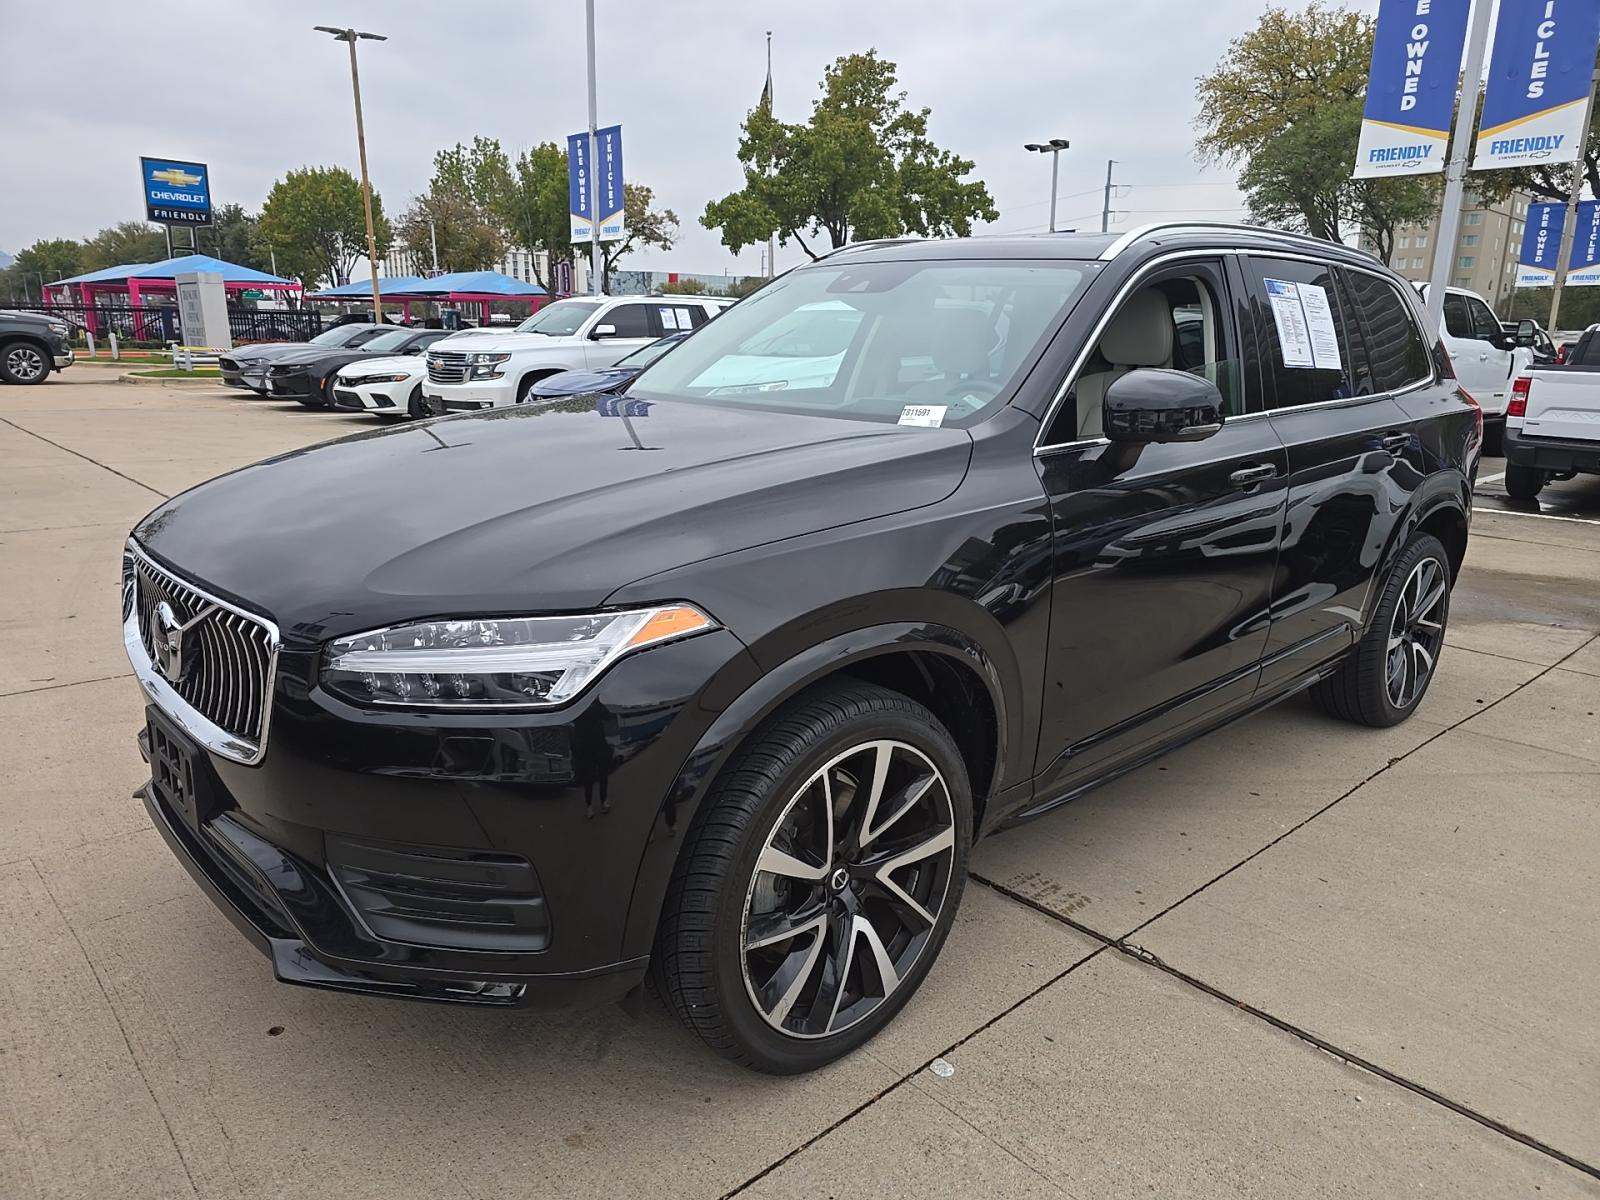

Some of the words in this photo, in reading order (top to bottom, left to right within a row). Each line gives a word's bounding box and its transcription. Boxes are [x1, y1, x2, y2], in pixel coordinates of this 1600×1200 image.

[1526, 0, 1556, 99] ICLES
[1400, 23, 1430, 111] OWNED
[1369, 144, 1433, 162] FRIENDLY
[1490, 134, 1565, 155] FRIENDLY
[151, 190, 205, 203] CHEVROLET
[578, 169, 586, 212] OWNED
[154, 209, 207, 221] FRIENDLY
[1541, 206, 1551, 228] PRE
[1534, 229, 1548, 263] OWNED
